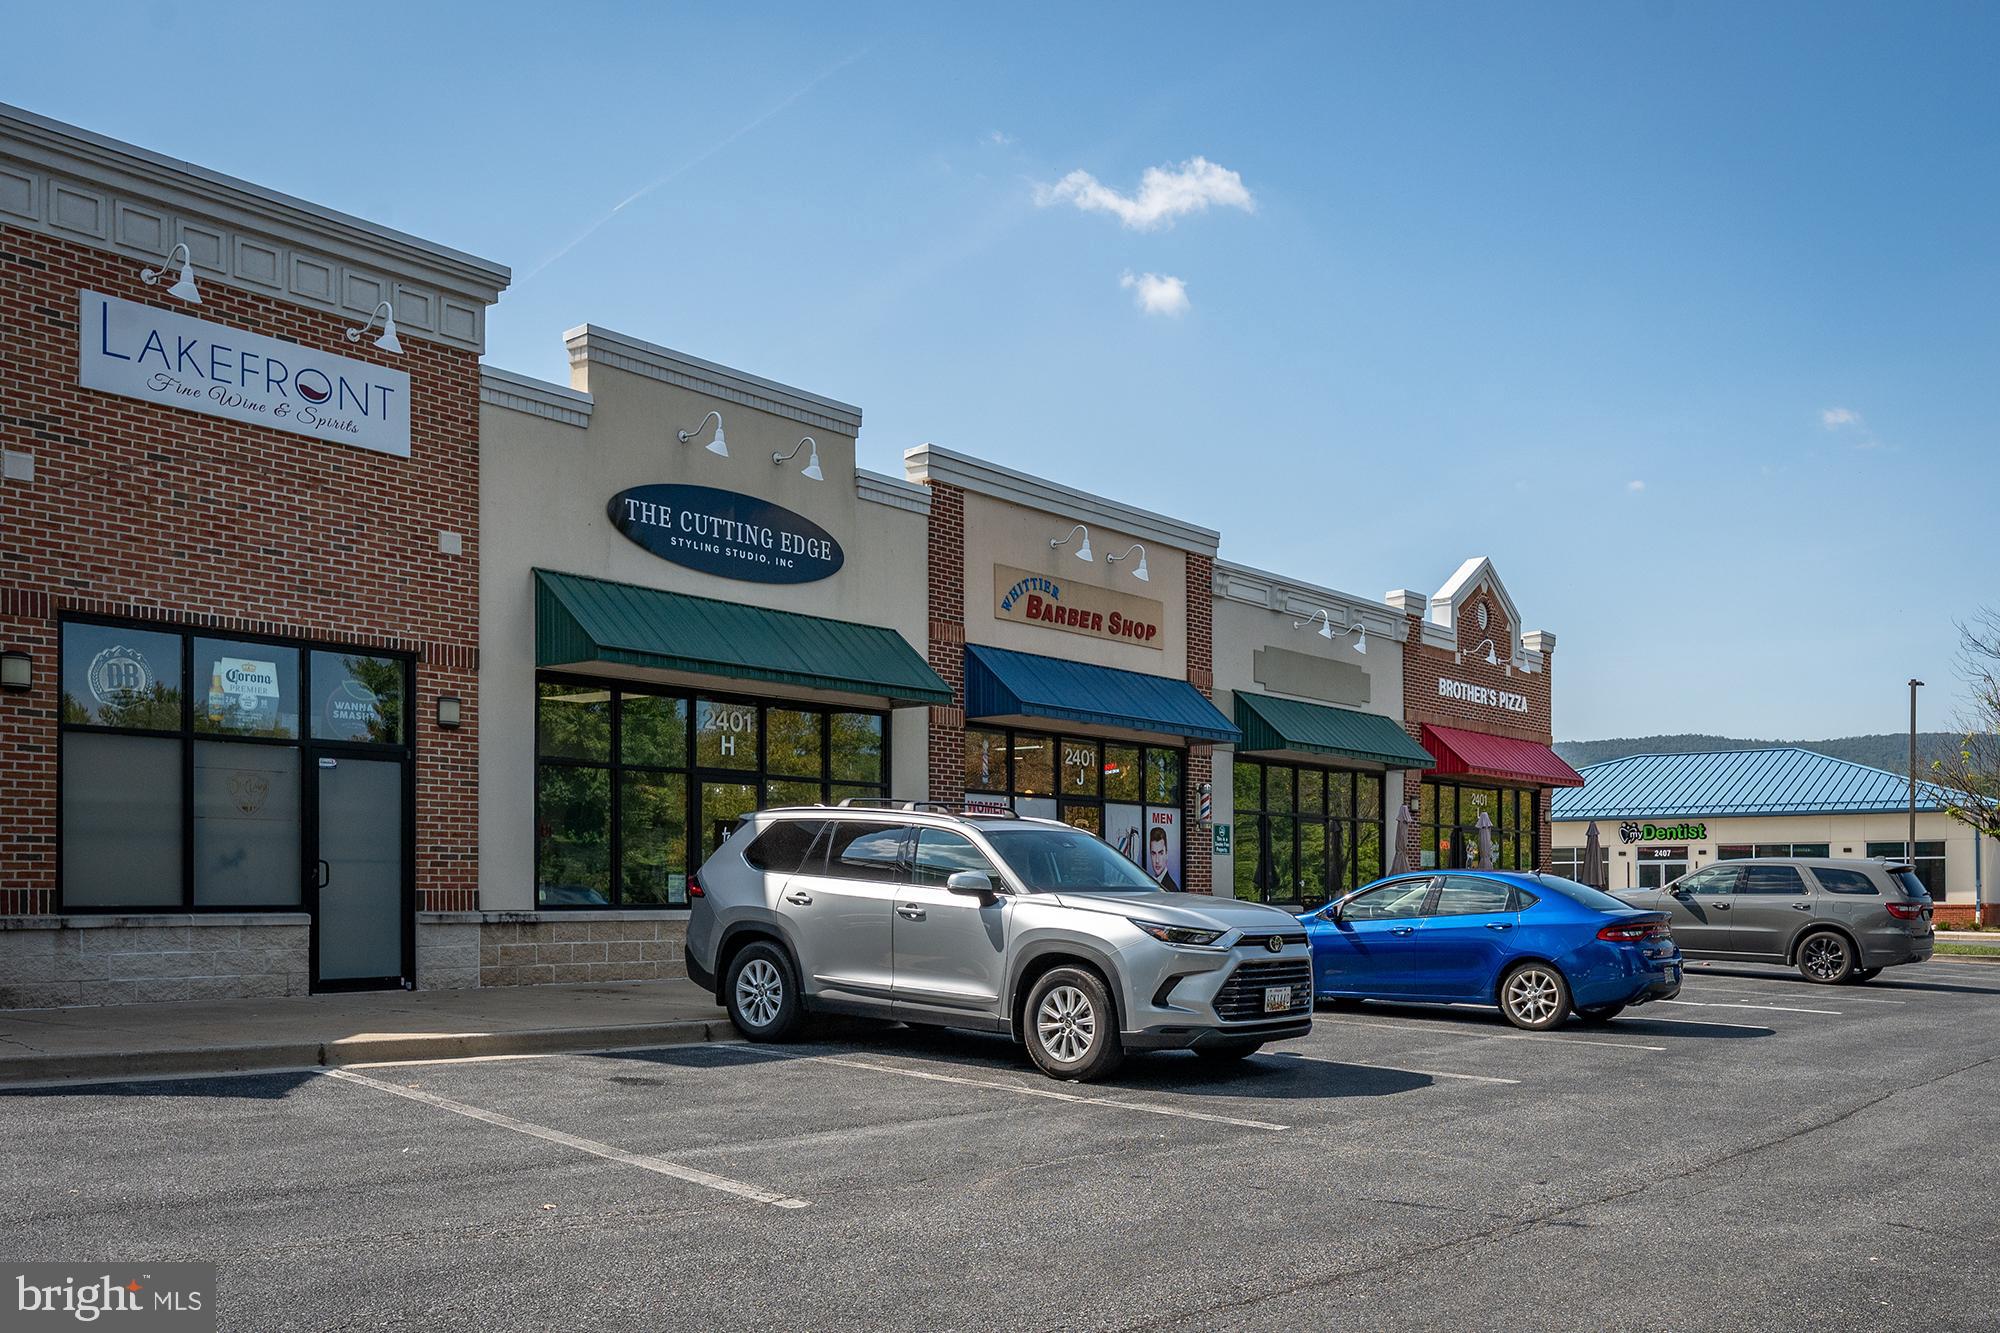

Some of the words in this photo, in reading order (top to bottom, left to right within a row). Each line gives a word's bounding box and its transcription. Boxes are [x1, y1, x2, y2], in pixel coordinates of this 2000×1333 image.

[102, 301, 395, 421] LAKEFRONT
[147, 373, 201, 400] Fine
[208, 385, 266, 413] Wine
[274, 402, 292, 418] &
[296, 406, 360, 434] Spirits
[625, 498, 671, 528] THE
[680, 511, 773, 549] CUTTING
[780, 531, 831, 561] EDGE
[670, 536, 720, 554] STYLING
[725, 547, 771, 565] STUDIO,
[775, 557, 794, 568] INC
[1001, 575, 1061, 612] WHITTIER
[1026, 594, 1104, 631] BARBER
[1108, 611, 1157, 641] SHOP
[225, 668, 272, 685] Corona
[230, 685, 268, 694] PREMIER
[1438, 677, 1497, 707] BROTHER'S
[1499, 691, 1528, 713] PIZZA
[334, 701, 374, 713] WANNA
[703, 709, 751, 733] 2401
[721, 735, 735, 756] H
[1065, 748, 1095, 767] 2401
[1076, 769, 1084, 785] J
[1471, 793, 1488, 806] 2401
[1152, 812, 1173, 824] MEN
[1654, 849, 1672, 857] 2407
